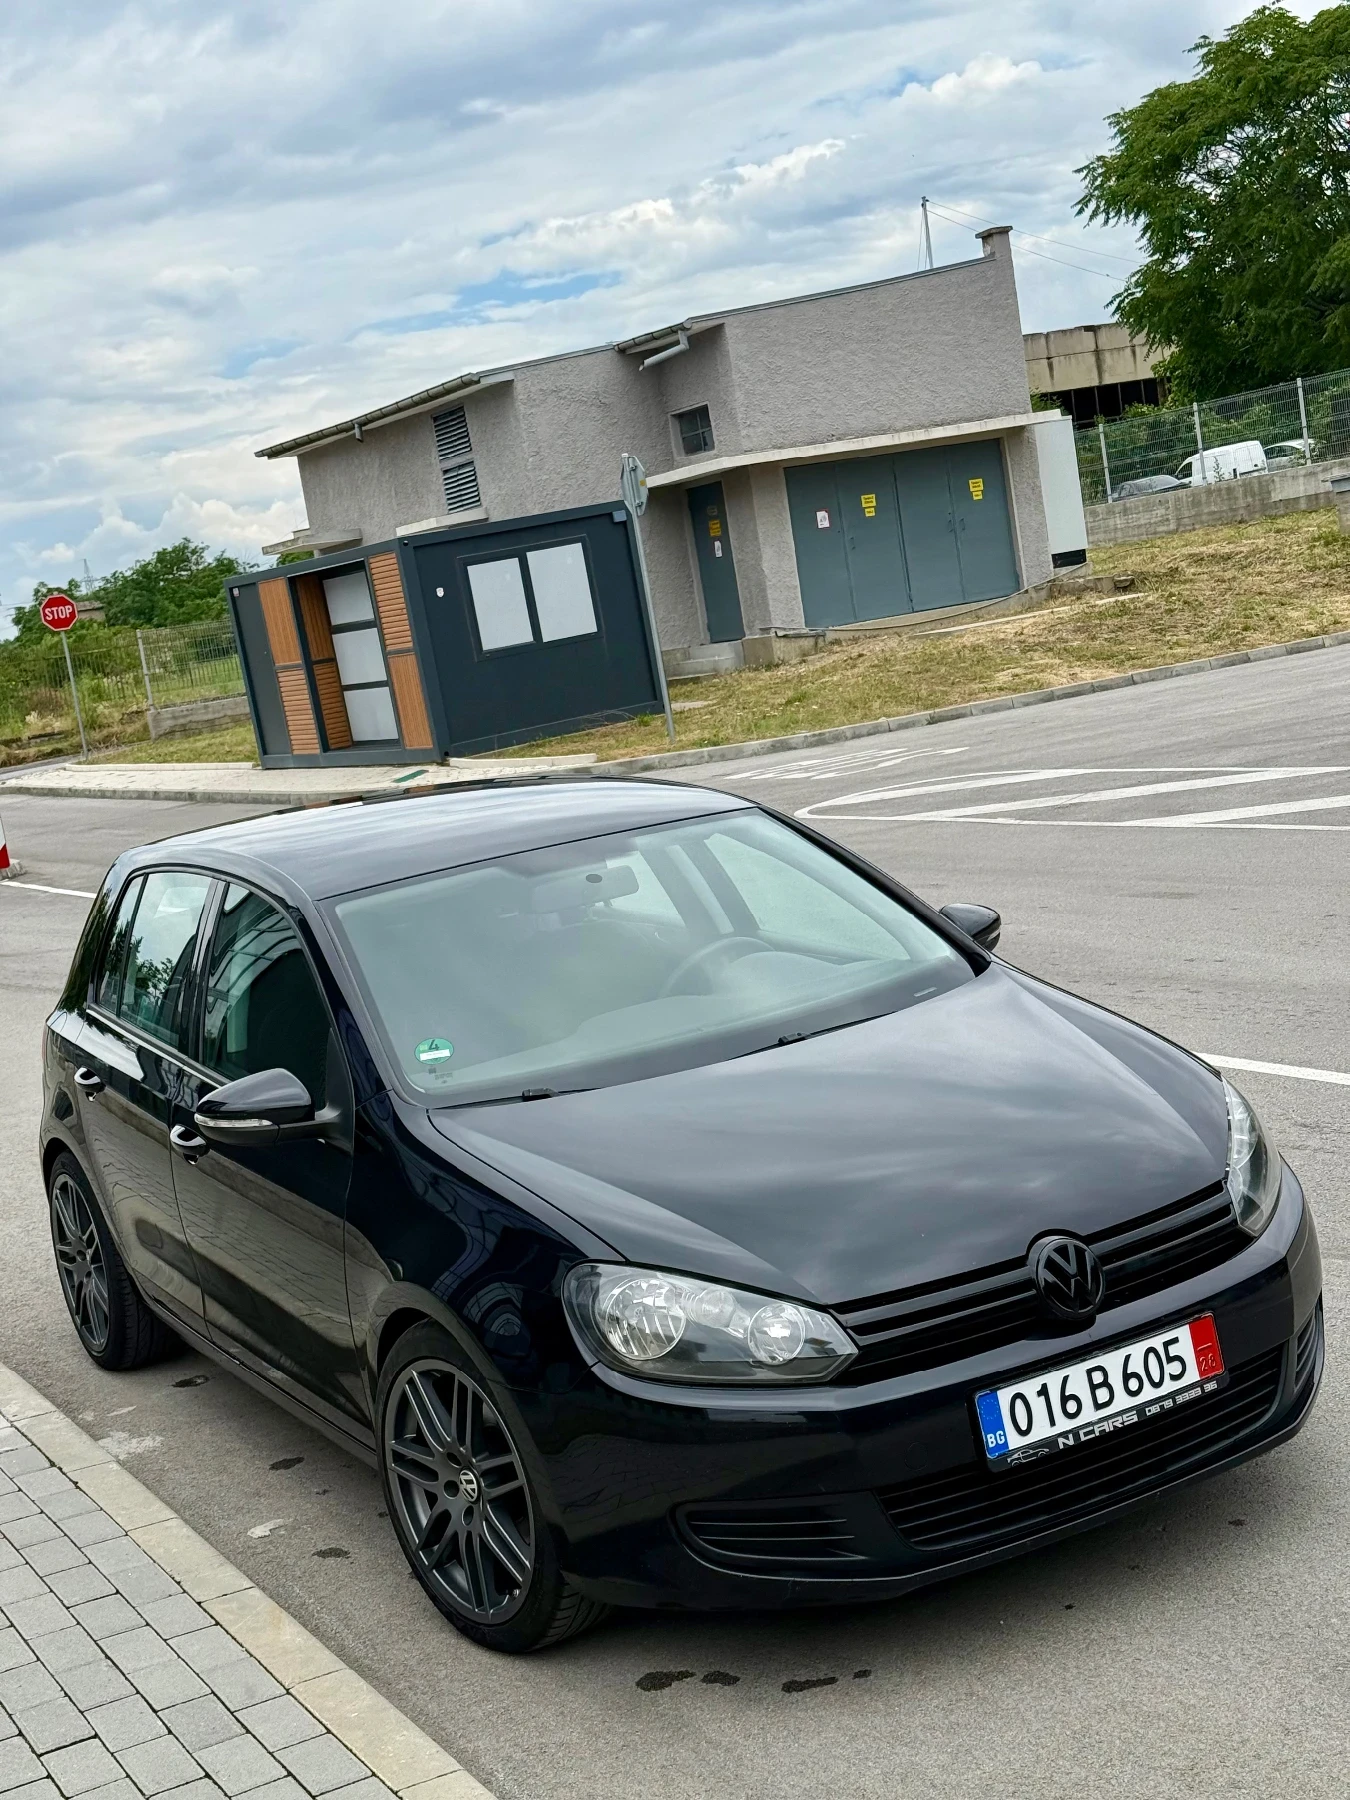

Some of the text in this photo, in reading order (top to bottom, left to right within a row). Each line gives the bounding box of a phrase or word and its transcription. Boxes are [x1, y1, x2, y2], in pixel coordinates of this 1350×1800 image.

[44, 605, 73, 621] STOP
[428, 1039, 440, 1051] 4
[1057, 1434, 1075, 1450] N
[1079, 1410, 1139, 1441] CARS
[1145, 1399, 1174, 1416] 0879
[986, 1430, 1005, 1448] BG
